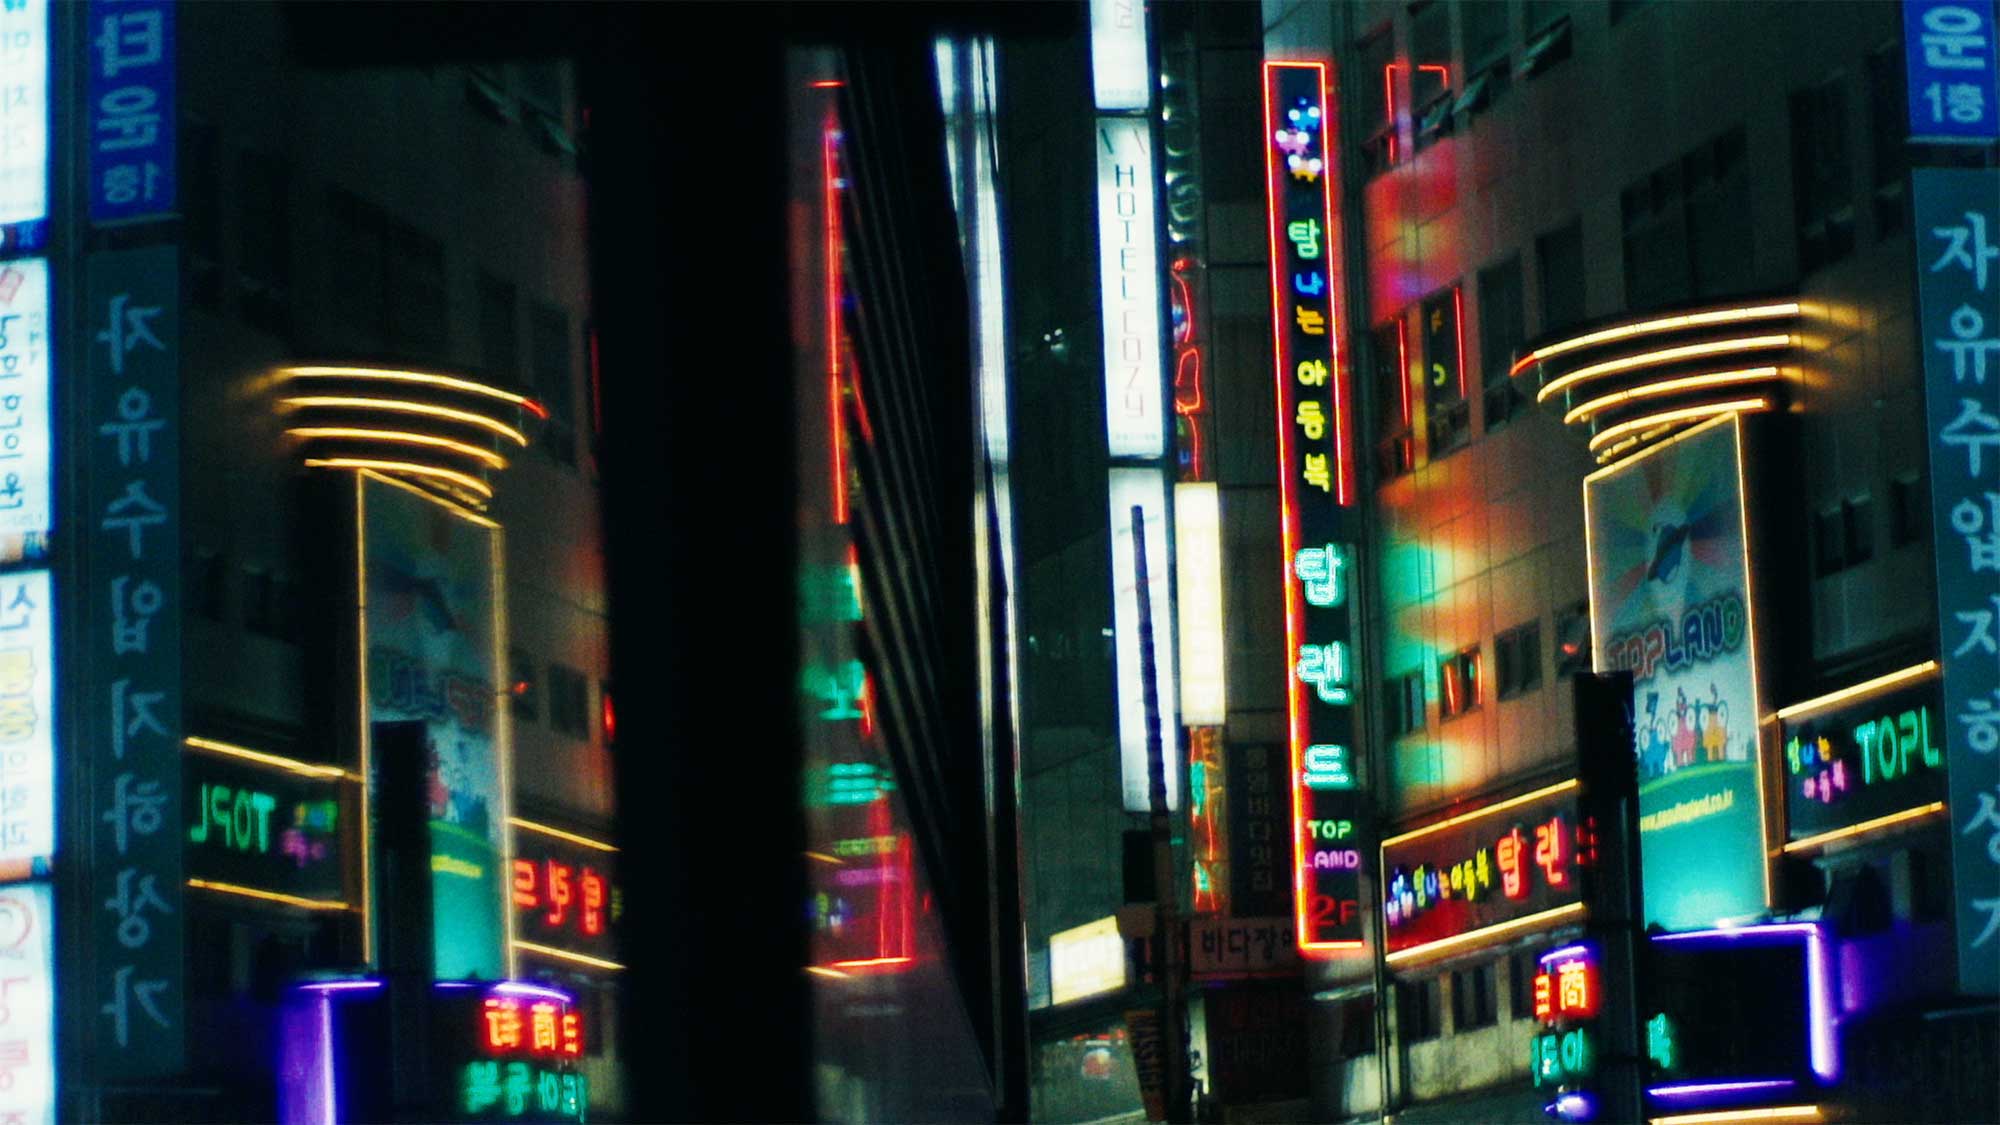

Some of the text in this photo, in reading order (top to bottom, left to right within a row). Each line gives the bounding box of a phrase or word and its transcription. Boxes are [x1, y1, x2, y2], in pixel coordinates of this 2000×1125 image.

[1924, 81, 1985, 123] 1층
[1115, 164, 1137, 300] HOTEL
[1288, 218, 1330, 493] 탐나는 아동복
[1295, 542, 1351, 784] 탑랜드
[1607, 597, 1745, 681] TOPLAND
[1855, 705, 1940, 785] TOPL
[1307, 819, 1351, 840] TOP
[1312, 894, 1359, 927] 2F
[1451, 847, 1490, 902] 아동복
